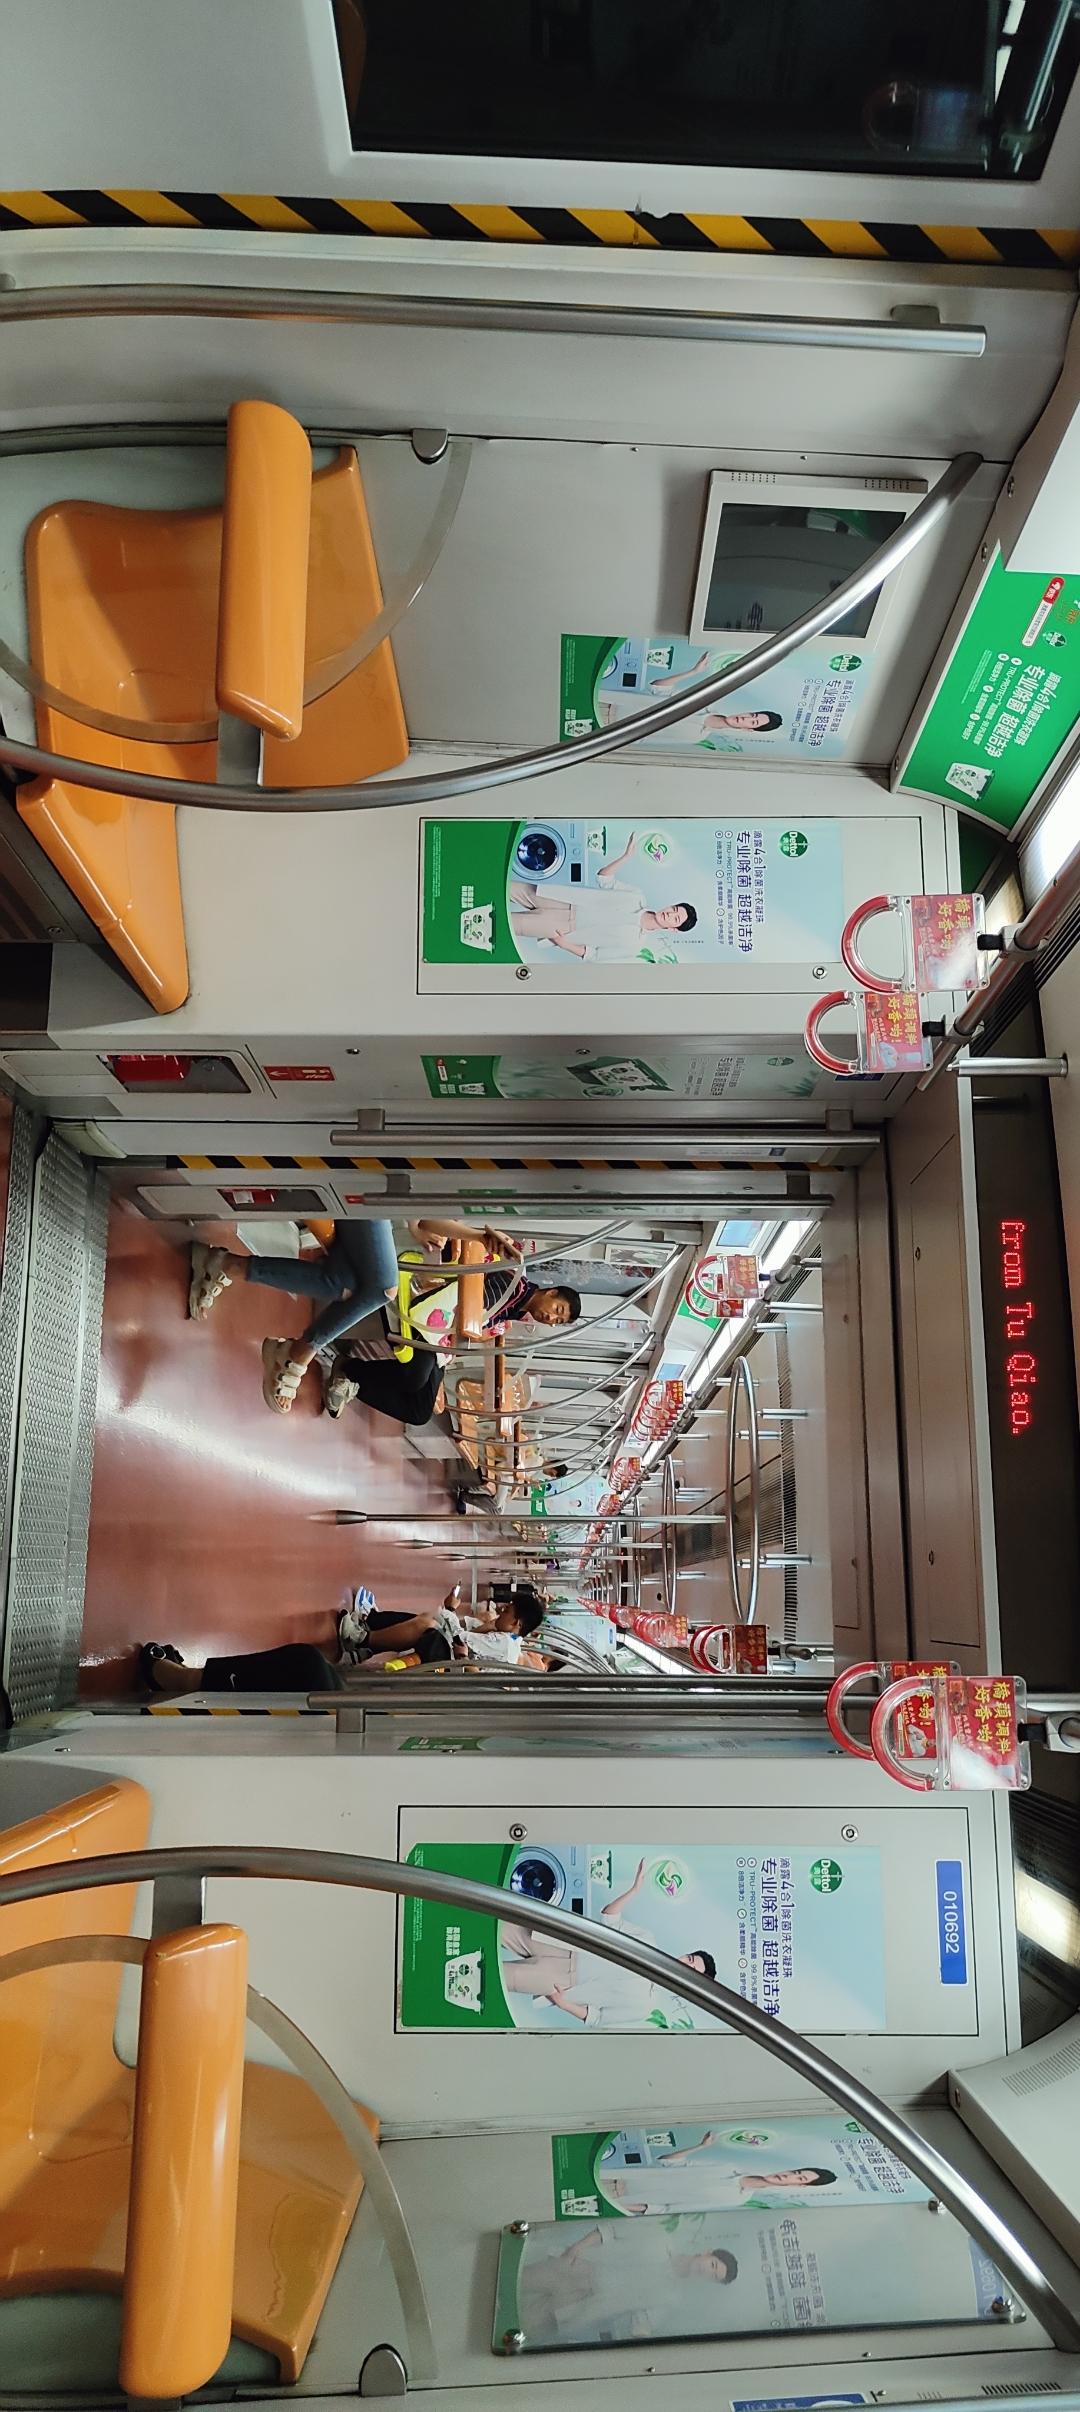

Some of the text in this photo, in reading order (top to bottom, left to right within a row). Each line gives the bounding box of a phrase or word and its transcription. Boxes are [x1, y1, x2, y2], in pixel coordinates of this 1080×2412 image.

[818, 680, 842, 713] 专业除菌
[1006, 665, 1046, 715] 专业除菌
[807, 716, 830, 748] 超越洁净
[984, 712, 1020, 758] 超越洁净
[789, 831, 799, 858] Dettol
[736, 831, 753, 953] 专业除菌 超越洁净
[1001, 1221, 1037, 1435] from Tu Qiao.
[821, 1859, 832, 1892] Dettol
[761, 1858, 780, 2017] 专业除菌 超越洁净
[780, 1857, 795, 1978] 滴露4合1除菌洗衣凝珠
[943, 1890, 960, 1955] 010692
